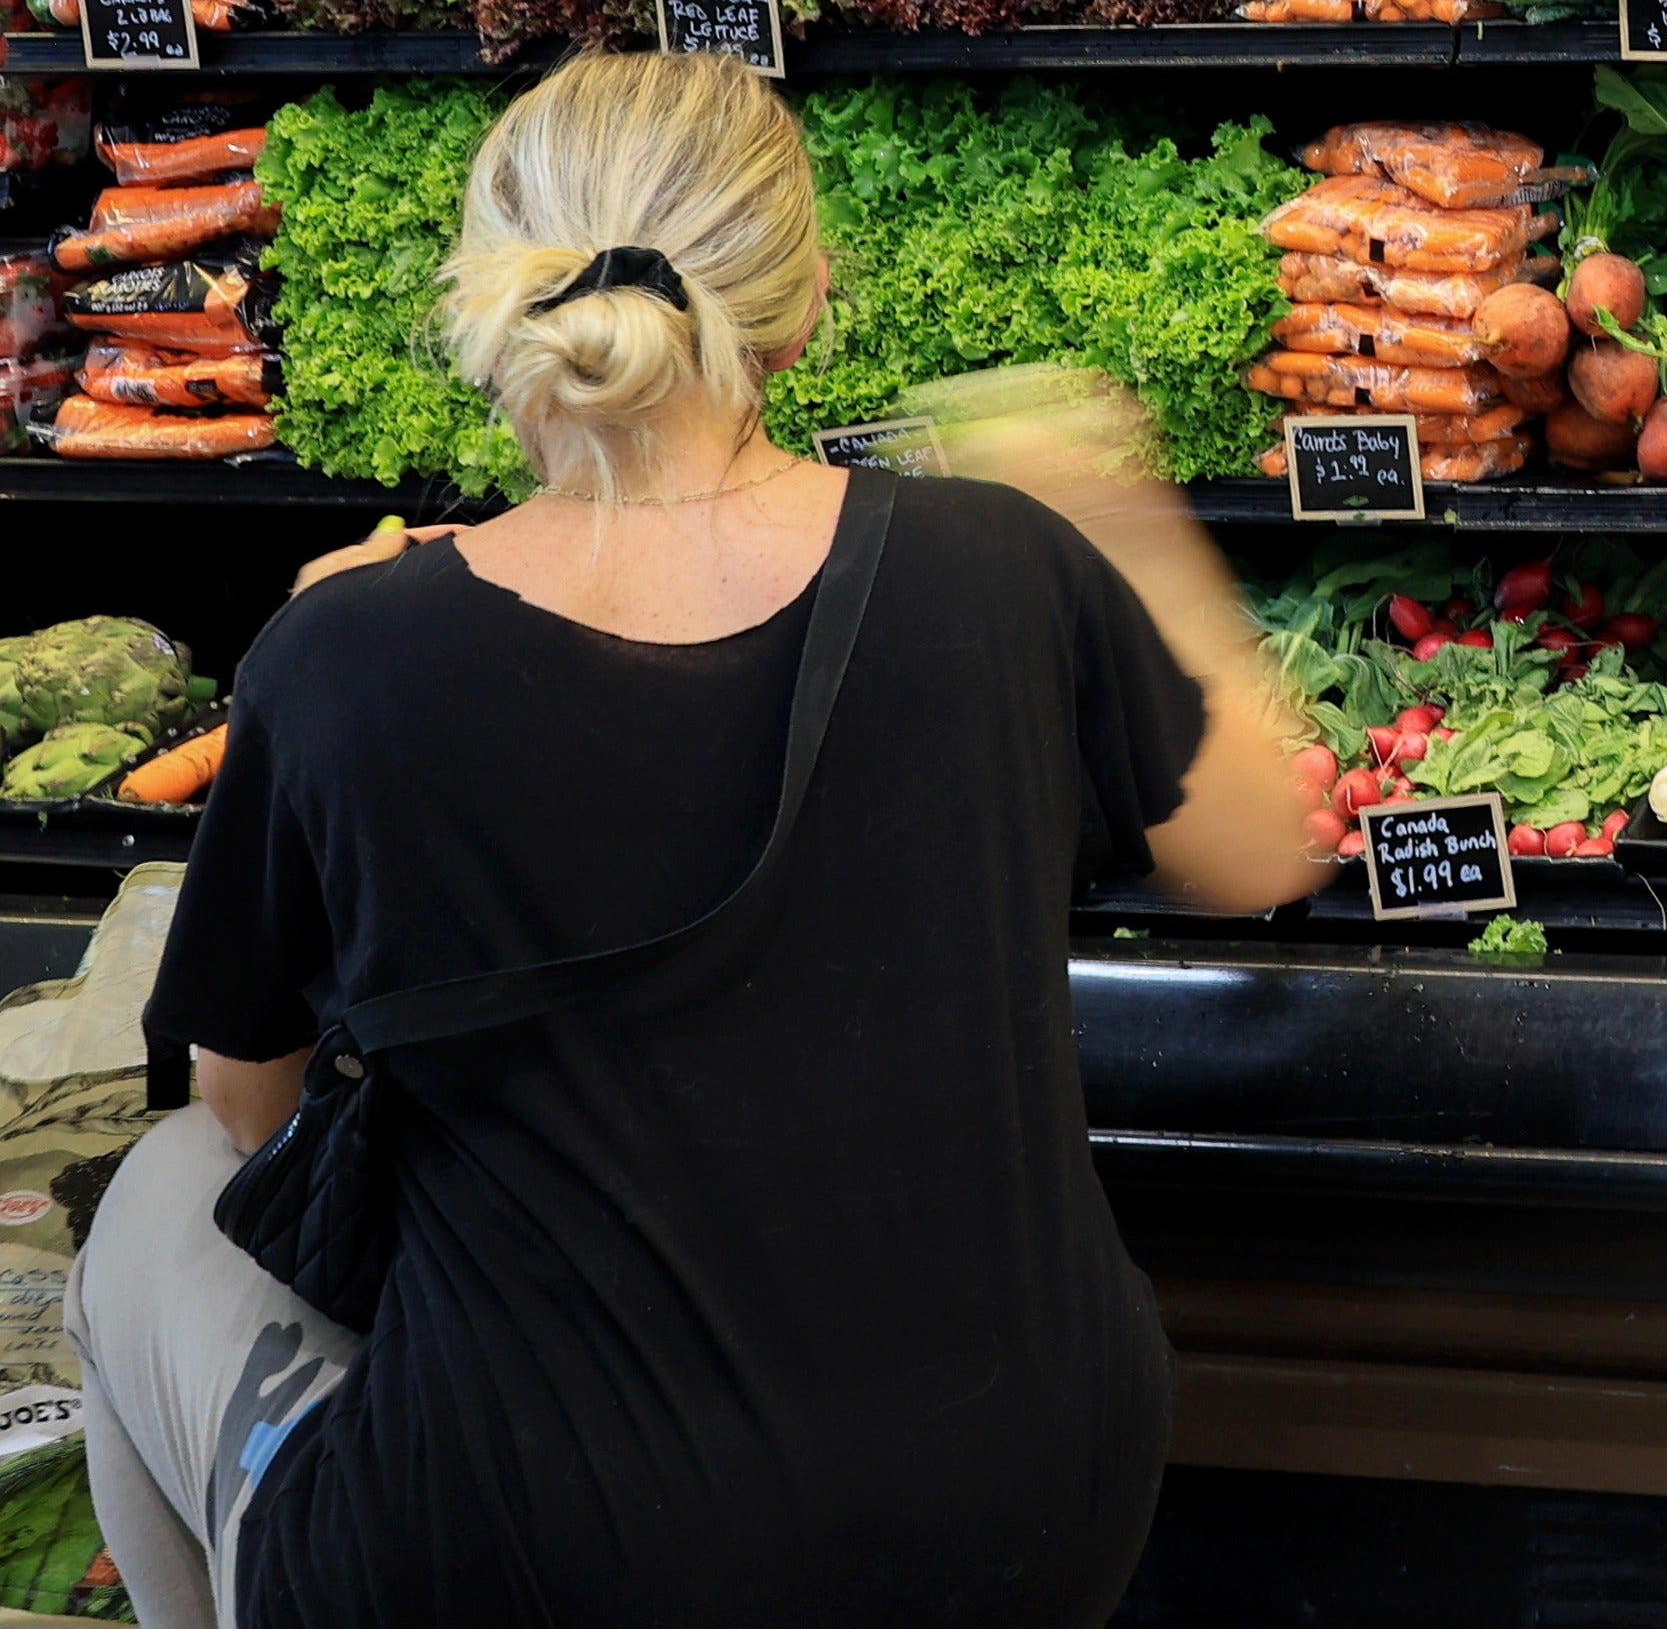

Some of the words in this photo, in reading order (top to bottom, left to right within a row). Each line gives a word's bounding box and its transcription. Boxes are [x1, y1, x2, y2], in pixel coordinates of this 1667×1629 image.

[716, 4, 760, 25] LEAF
[106, 29, 160, 61] $2.99
[689, 20, 760, 42] LETTUCE
[1292, 426, 1348, 453] Carrots
[1352, 429, 1400, 461] Baby
[1380, 811, 1450, 839] Canada
[1377, 836, 1440, 865] Radish
[1444, 828, 1498, 855] Bunch
[1390, 859, 1454, 898] $1.99
[1459, 863, 1483, 882] ea
